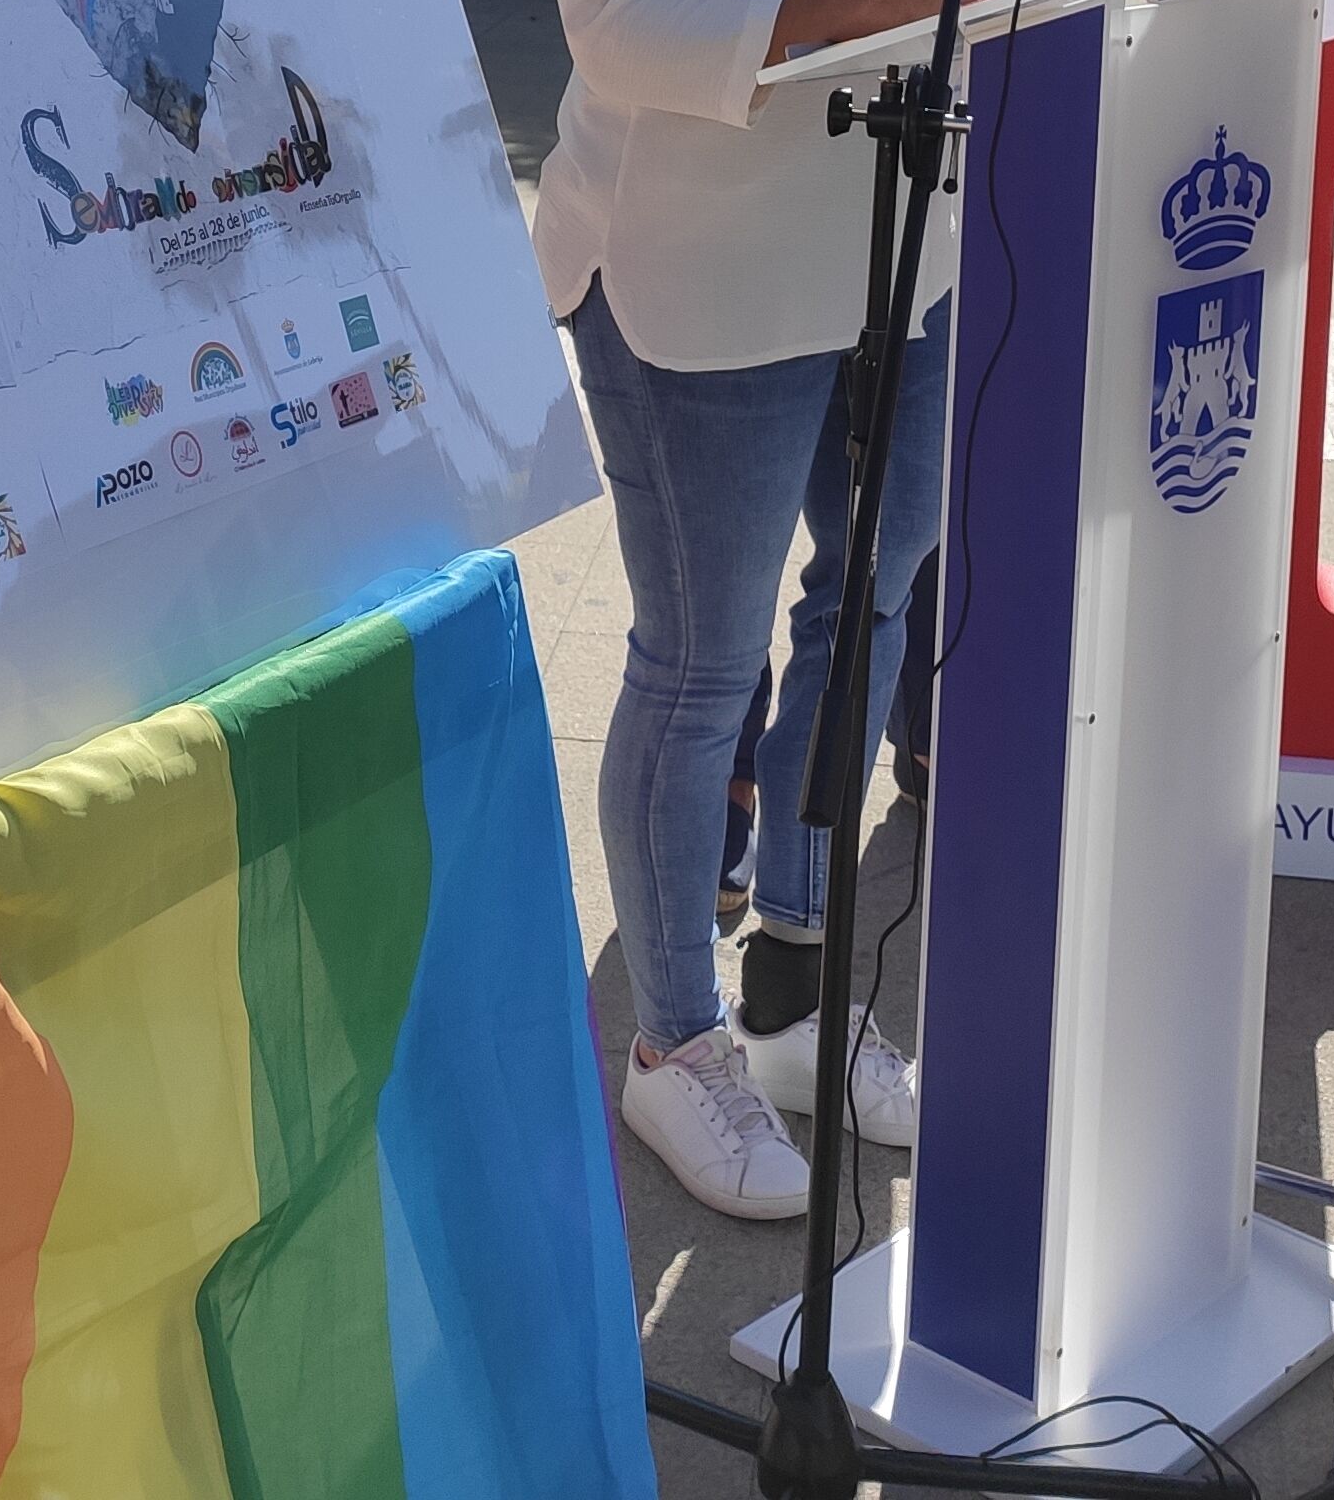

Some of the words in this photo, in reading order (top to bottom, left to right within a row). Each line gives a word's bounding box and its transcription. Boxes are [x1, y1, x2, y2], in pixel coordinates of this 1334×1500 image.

[160, 232, 182, 255] Del
[181, 227, 198, 247] 25
[199, 223, 211, 241] al
[212, 218, 226, 236] 28
[226, 213, 241, 230] de
[241, 204, 271, 227] junio.
[270, 397, 317, 449] Stilo
